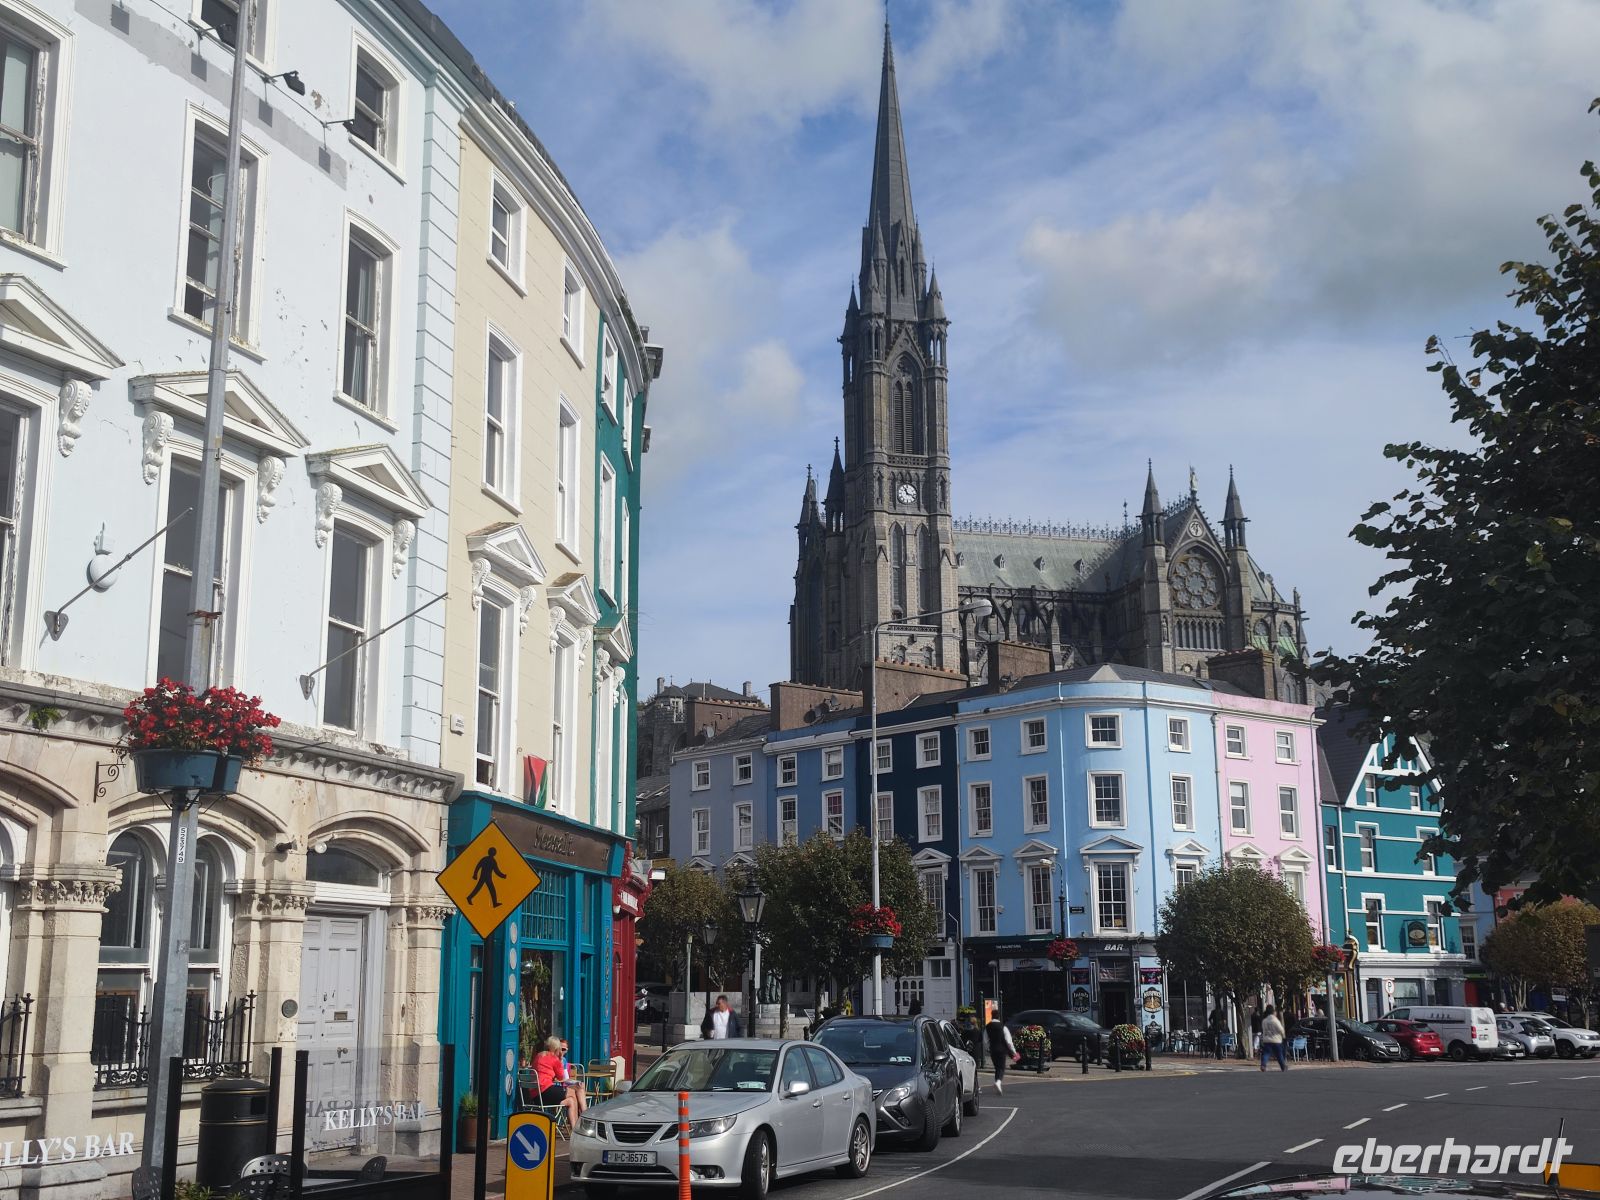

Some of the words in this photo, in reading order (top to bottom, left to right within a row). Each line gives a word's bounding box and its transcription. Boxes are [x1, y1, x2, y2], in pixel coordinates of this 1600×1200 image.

[324, 1105, 392, 1131] KELLY'S
[0, 1136, 77, 1166] LLY'S
[84, 1132, 135, 1159] BAR
